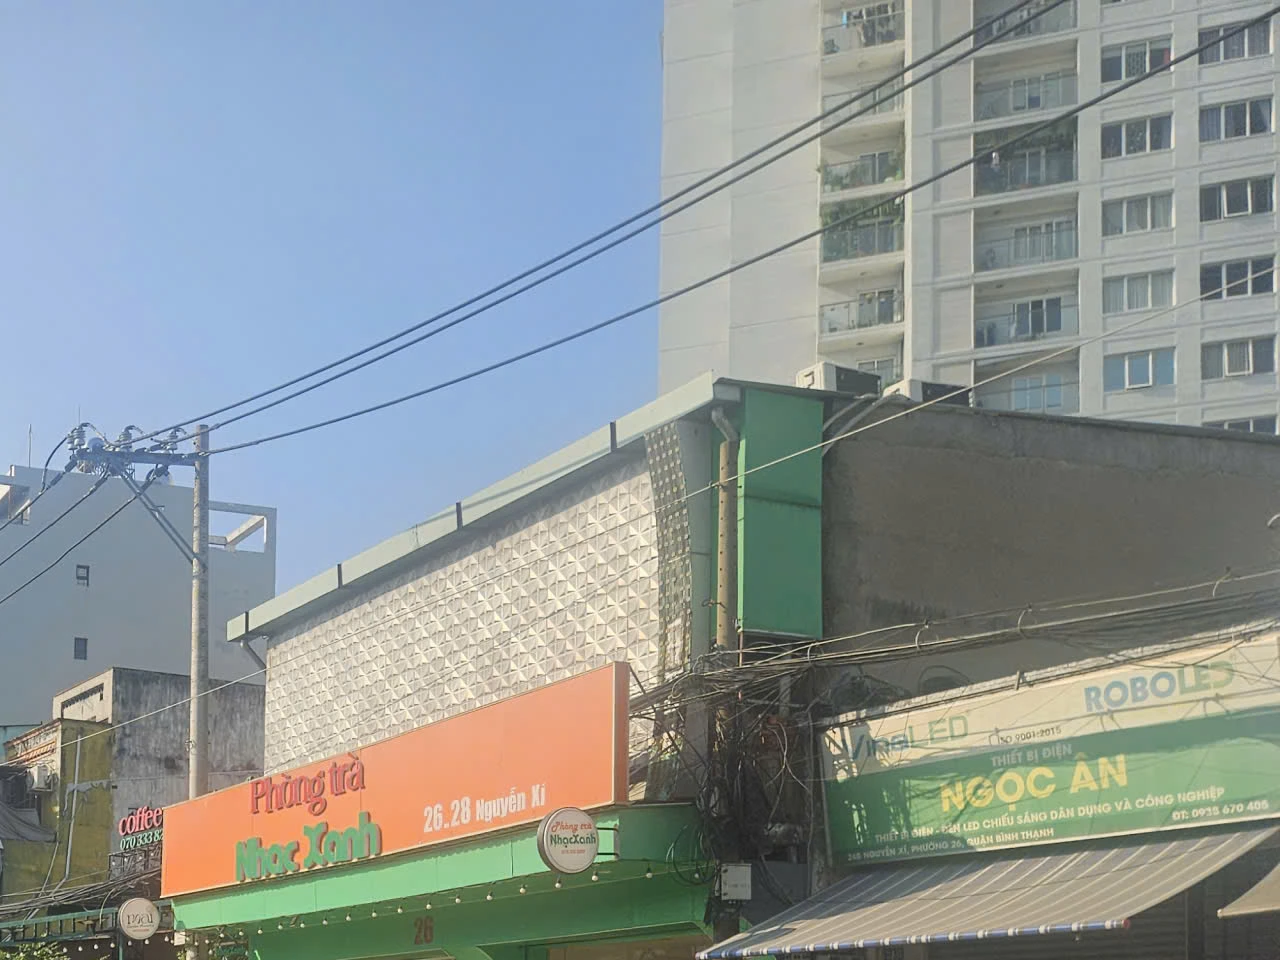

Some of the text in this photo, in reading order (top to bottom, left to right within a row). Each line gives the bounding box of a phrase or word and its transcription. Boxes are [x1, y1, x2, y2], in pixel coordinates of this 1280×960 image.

[1083, 660, 1235, 713] ROBOLED
[991, 748, 1023, 767] THIẾT
[1042, 743, 1073, 760] ĐIỆN
[250, 751, 366, 816] Phòng trà
[939, 766, 1057, 813] NGỌC
[119, 806, 162, 836] coffee
[423, 796, 472, 833] 26.28
[963, 820, 980, 832] LED
[982, 812, 1014, 830] CHIẾU
[1016, 808, 1048, 825] SÁNG
[1050, 806, 1075, 821] DÂN
[1077, 803, 1112, 818] DỤNG
[1114, 799, 1132, 811] VÀ
[1135, 793, 1174, 808] CÔNG
[1177, 785, 1225, 804] NGHIỆP
[303, 811, 383, 869] Xanh
[995, 829, 1019, 842] BÌNH
[413, 915, 434, 945] 26
